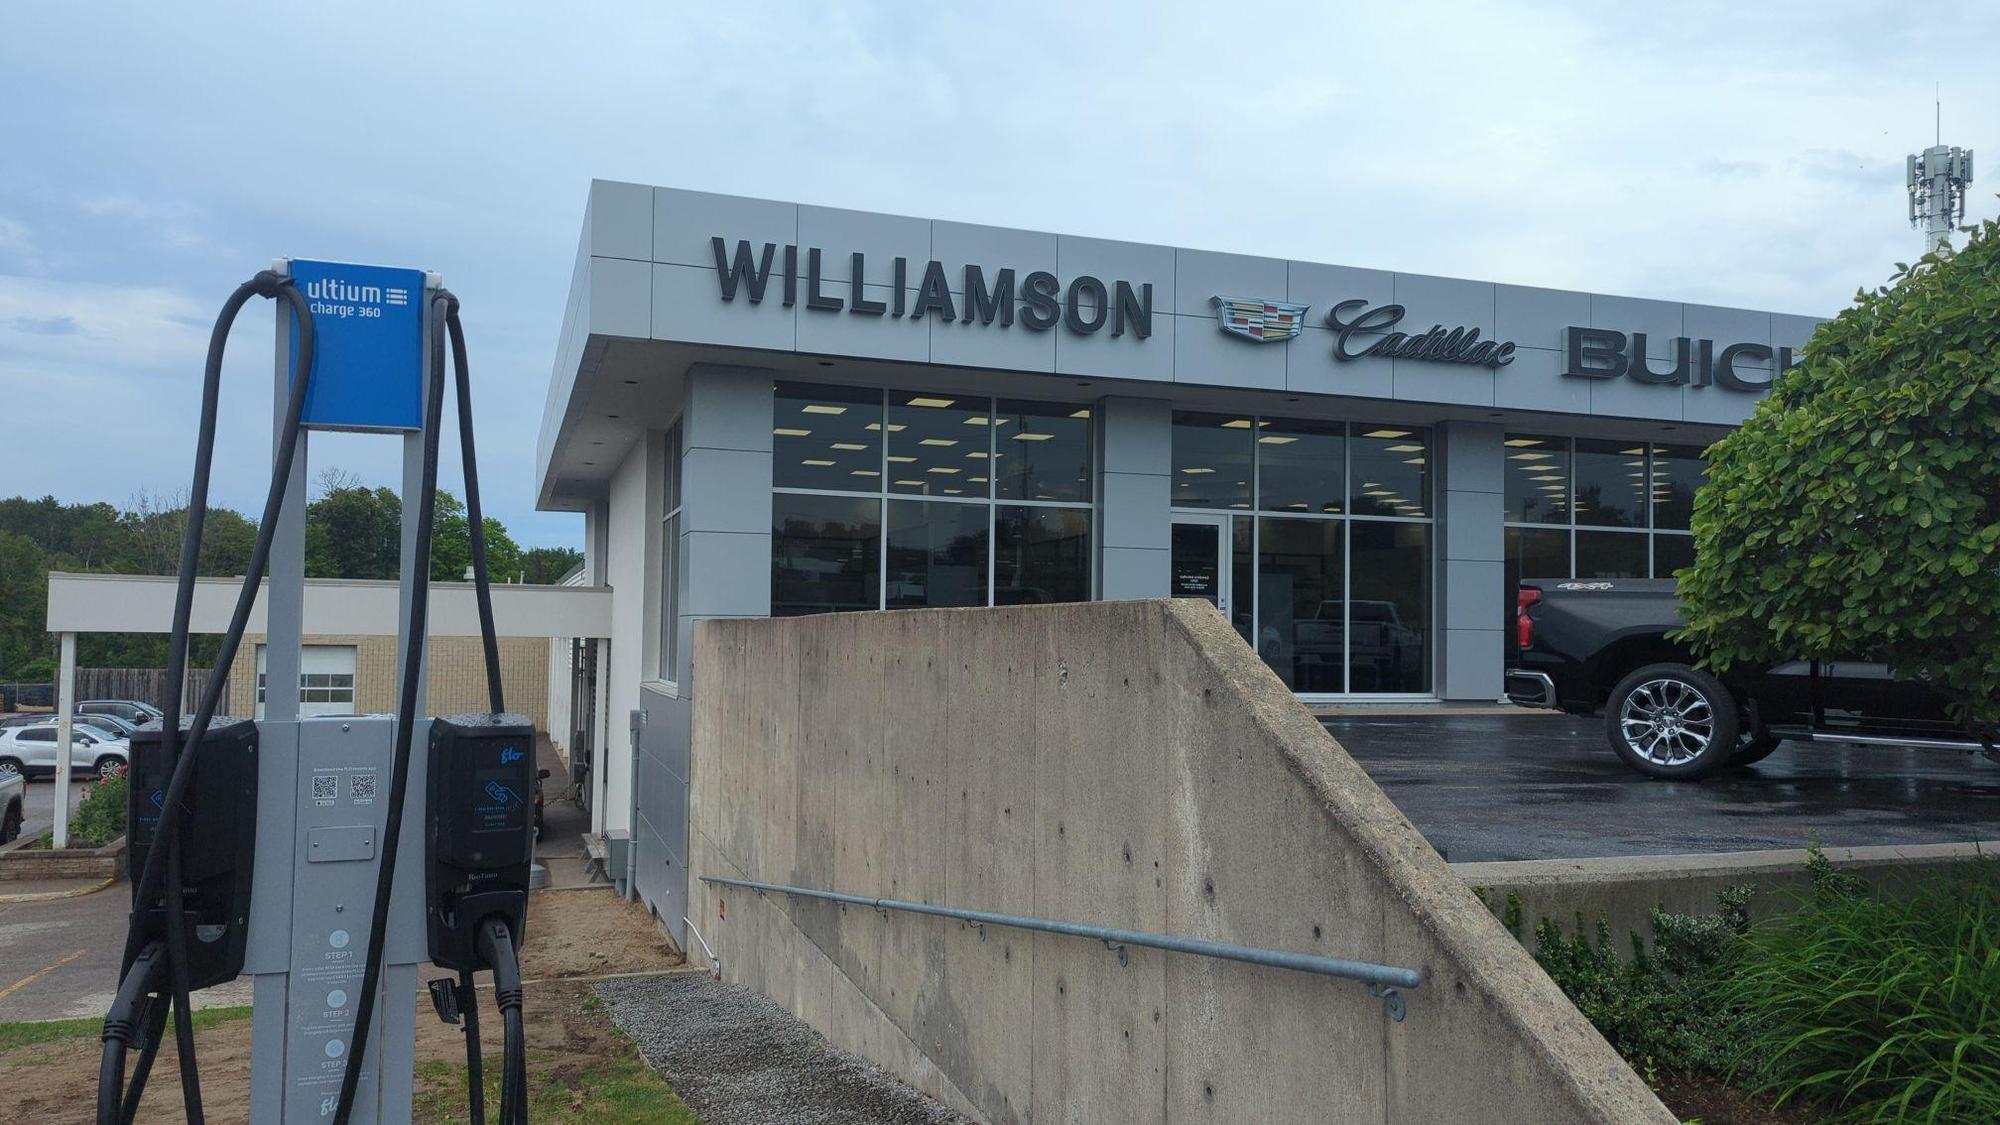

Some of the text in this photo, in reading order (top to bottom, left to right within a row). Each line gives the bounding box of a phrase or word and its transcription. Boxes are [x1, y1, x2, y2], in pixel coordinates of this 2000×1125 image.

[307, 278, 381, 304] ultium
[711, 236, 1153, 339] WILLIAMSON
[310, 301, 381, 319] charge 360
[1326, 299, 1516, 367] Cadillac
[500, 747, 525, 765] flo
[324, 951, 353, 960] STEP 1
[323, 1009, 350, 1018] STEP 2
[321, 1060, 342, 1069] STEP
